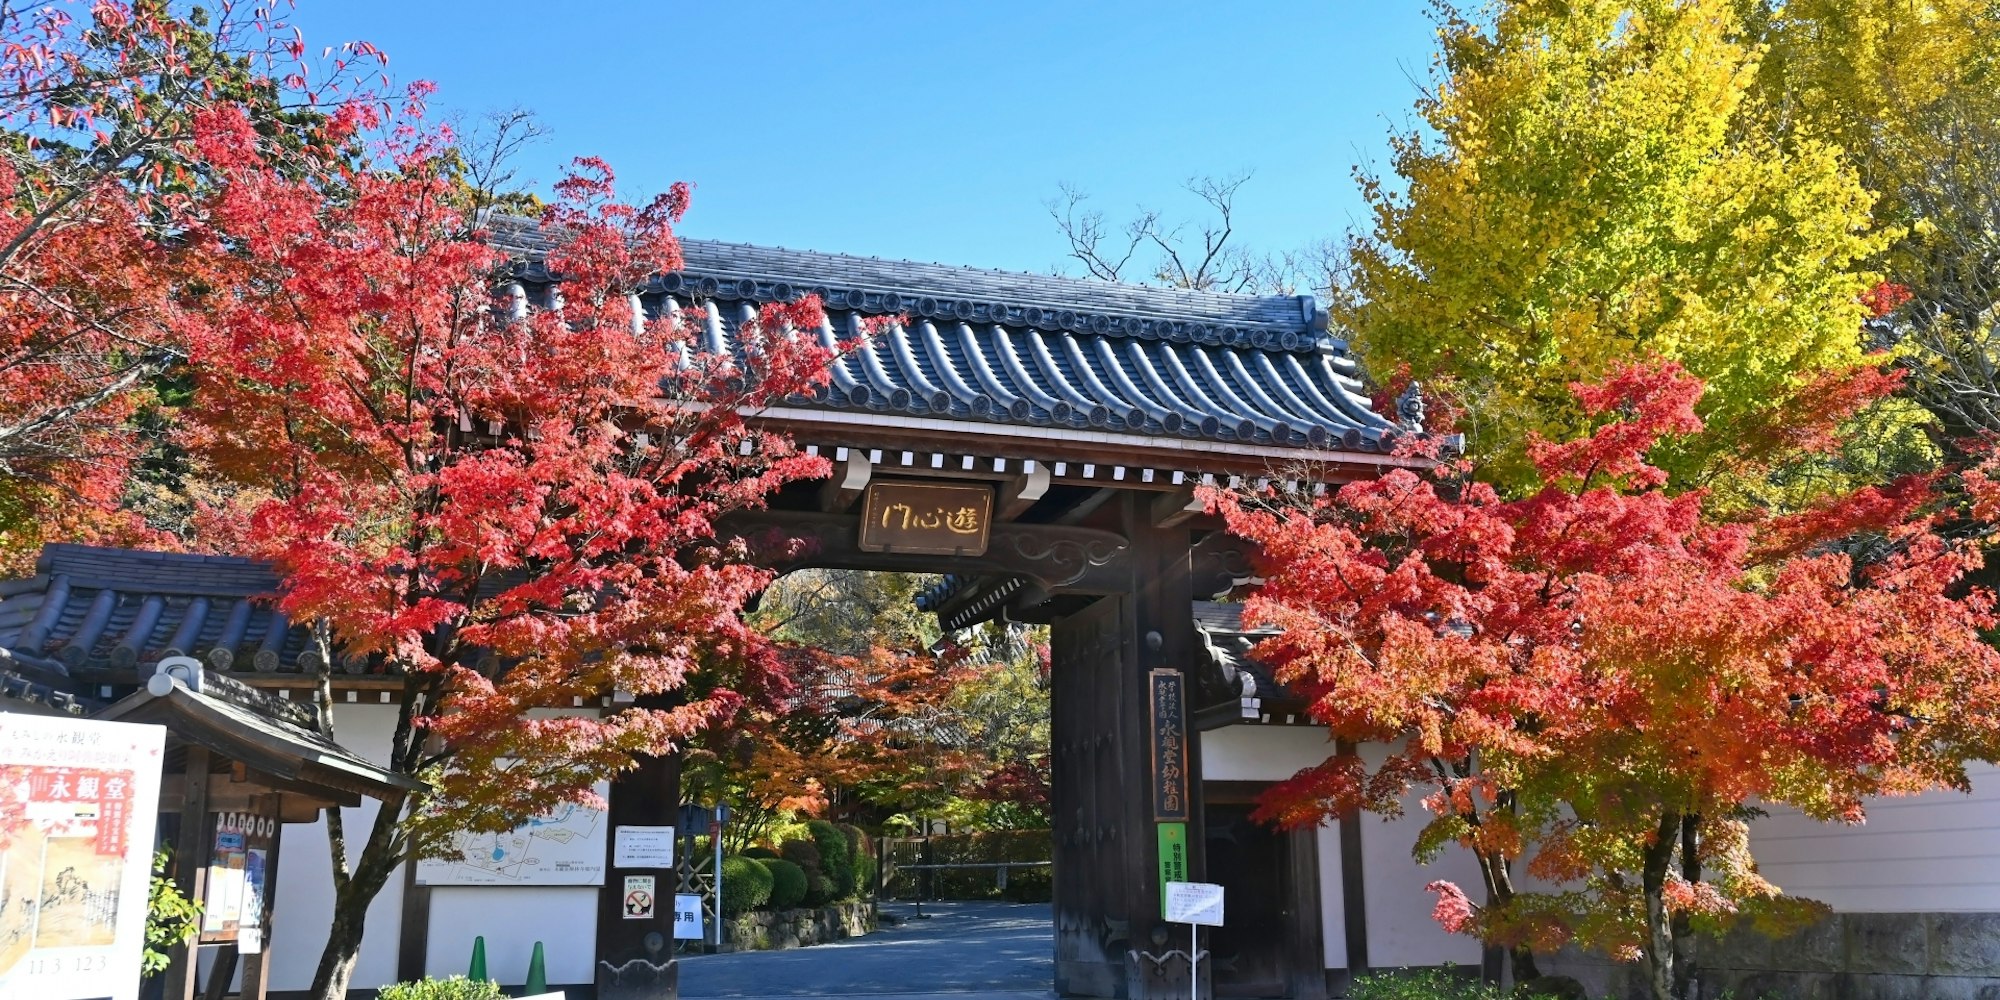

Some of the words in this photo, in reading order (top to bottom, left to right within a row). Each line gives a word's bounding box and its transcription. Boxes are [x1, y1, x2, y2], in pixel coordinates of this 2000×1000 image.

[48, 774, 127, 800] 永観堂
[1159, 719, 1181, 812] 永観堂幼稚園
